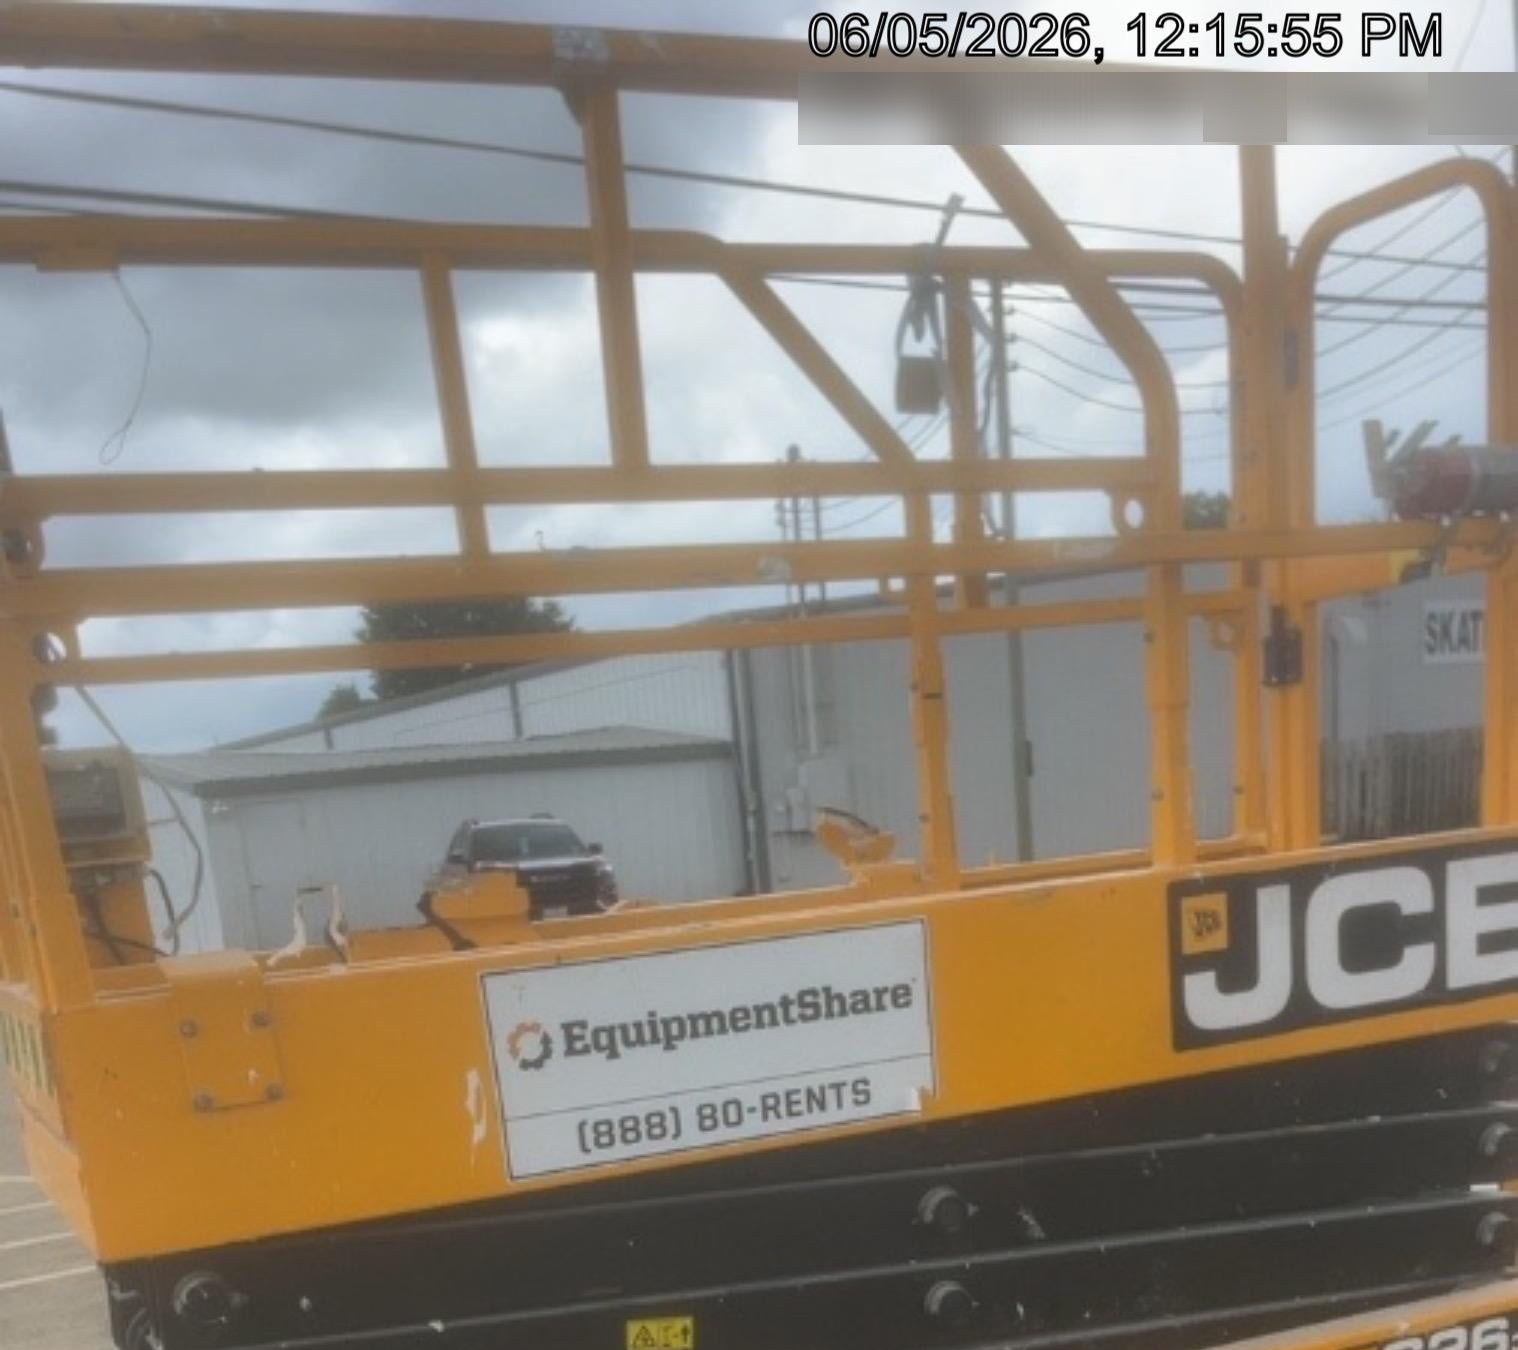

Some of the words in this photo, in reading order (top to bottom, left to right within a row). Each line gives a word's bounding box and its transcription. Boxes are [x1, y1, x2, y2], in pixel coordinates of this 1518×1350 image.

[561, 981, 914, 1060] EquipmentShare
[577, 1107, 682, 1153] (888)
[696, 1077, 872, 1132] 80-RENTS
